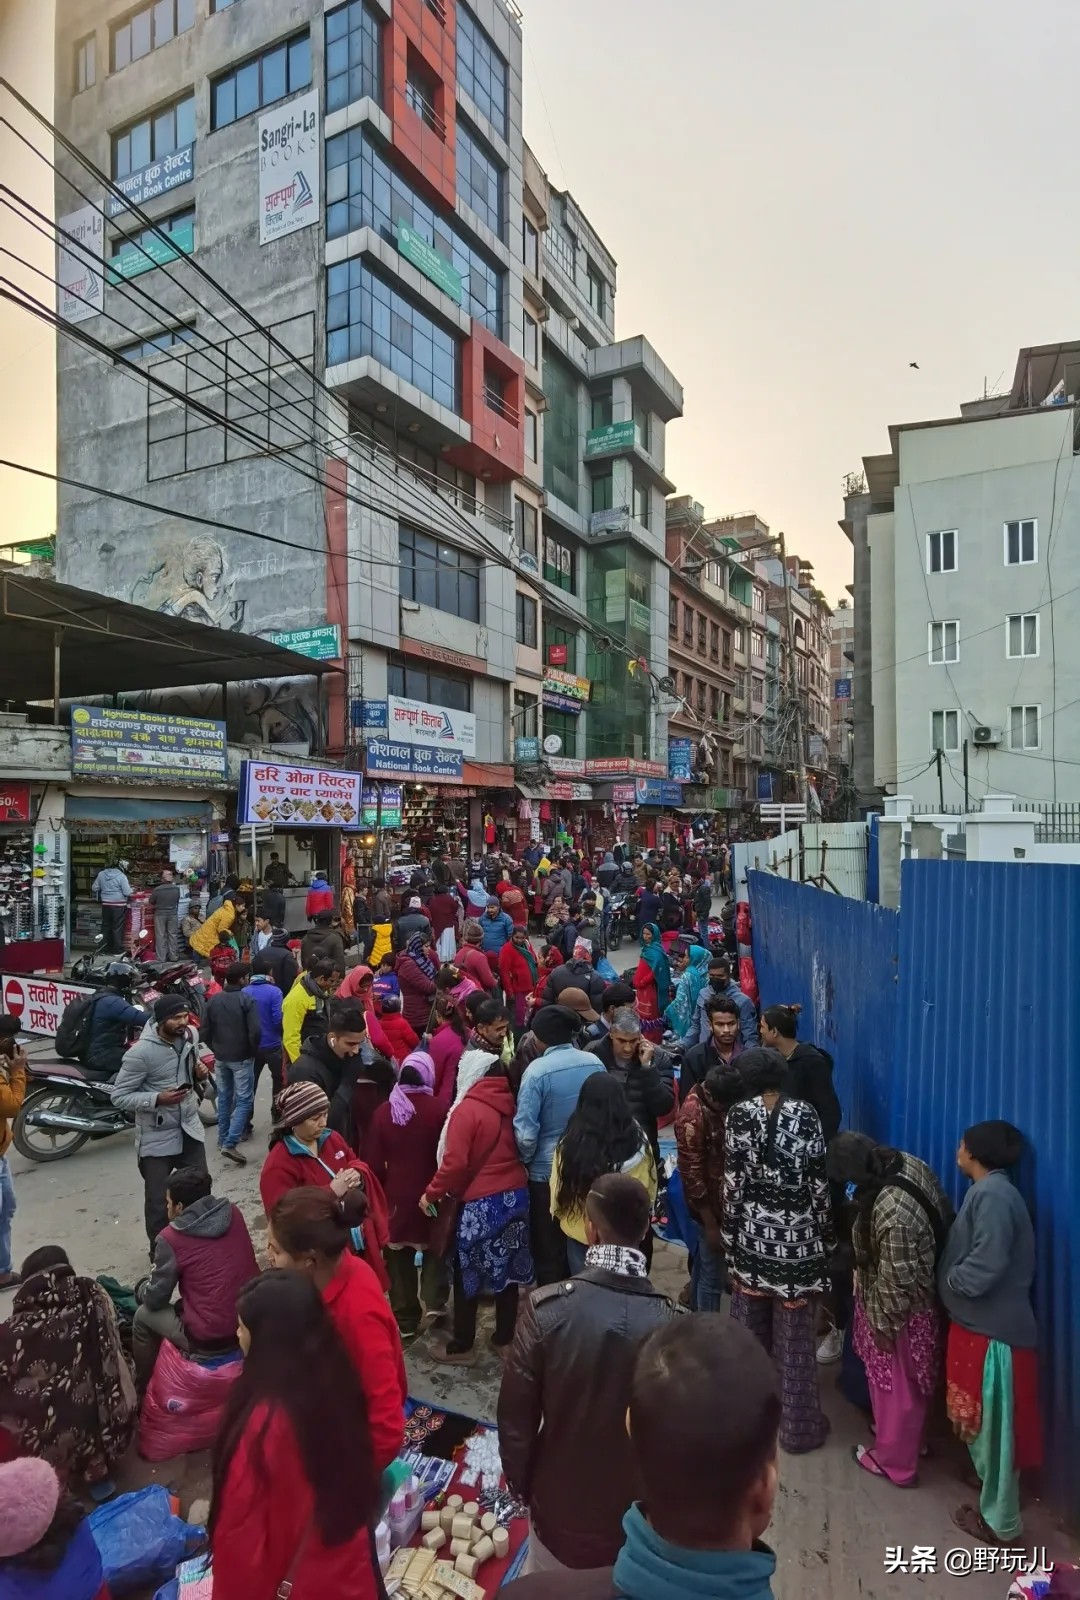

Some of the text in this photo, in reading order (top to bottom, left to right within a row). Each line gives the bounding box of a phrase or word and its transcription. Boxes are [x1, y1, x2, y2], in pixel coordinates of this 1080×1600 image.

[261, 133, 315, 172] BOOKS
[145, 164, 161, 185] बुक
[164, 148, 191, 173] सेन्टर
[144, 181, 163, 198] Book
[165, 168, 191, 188] Centre
[312, 627, 334, 638] भण्डार
[102, 710, 138, 720] Highland
[140, 713, 167, 723] Books
[369, 710, 380, 718] बुक
[394, 707, 443, 728] सम्पूर्ण किताब
[168, 725, 186, 735] एण्ड
[369, 738, 462, 765] नेशनल बुक सेन्टर
[254, 766, 356, 788] हरि ओम स्विट्स
[375, 760, 456, 775] National Book Centre
[259, 785, 286, 795] एण्ड
[315, 787, 352, 800] प्यालेस
[27, 982, 58, 1006] सवारी
[29, 1005, 57, 1032] प्रवेश
